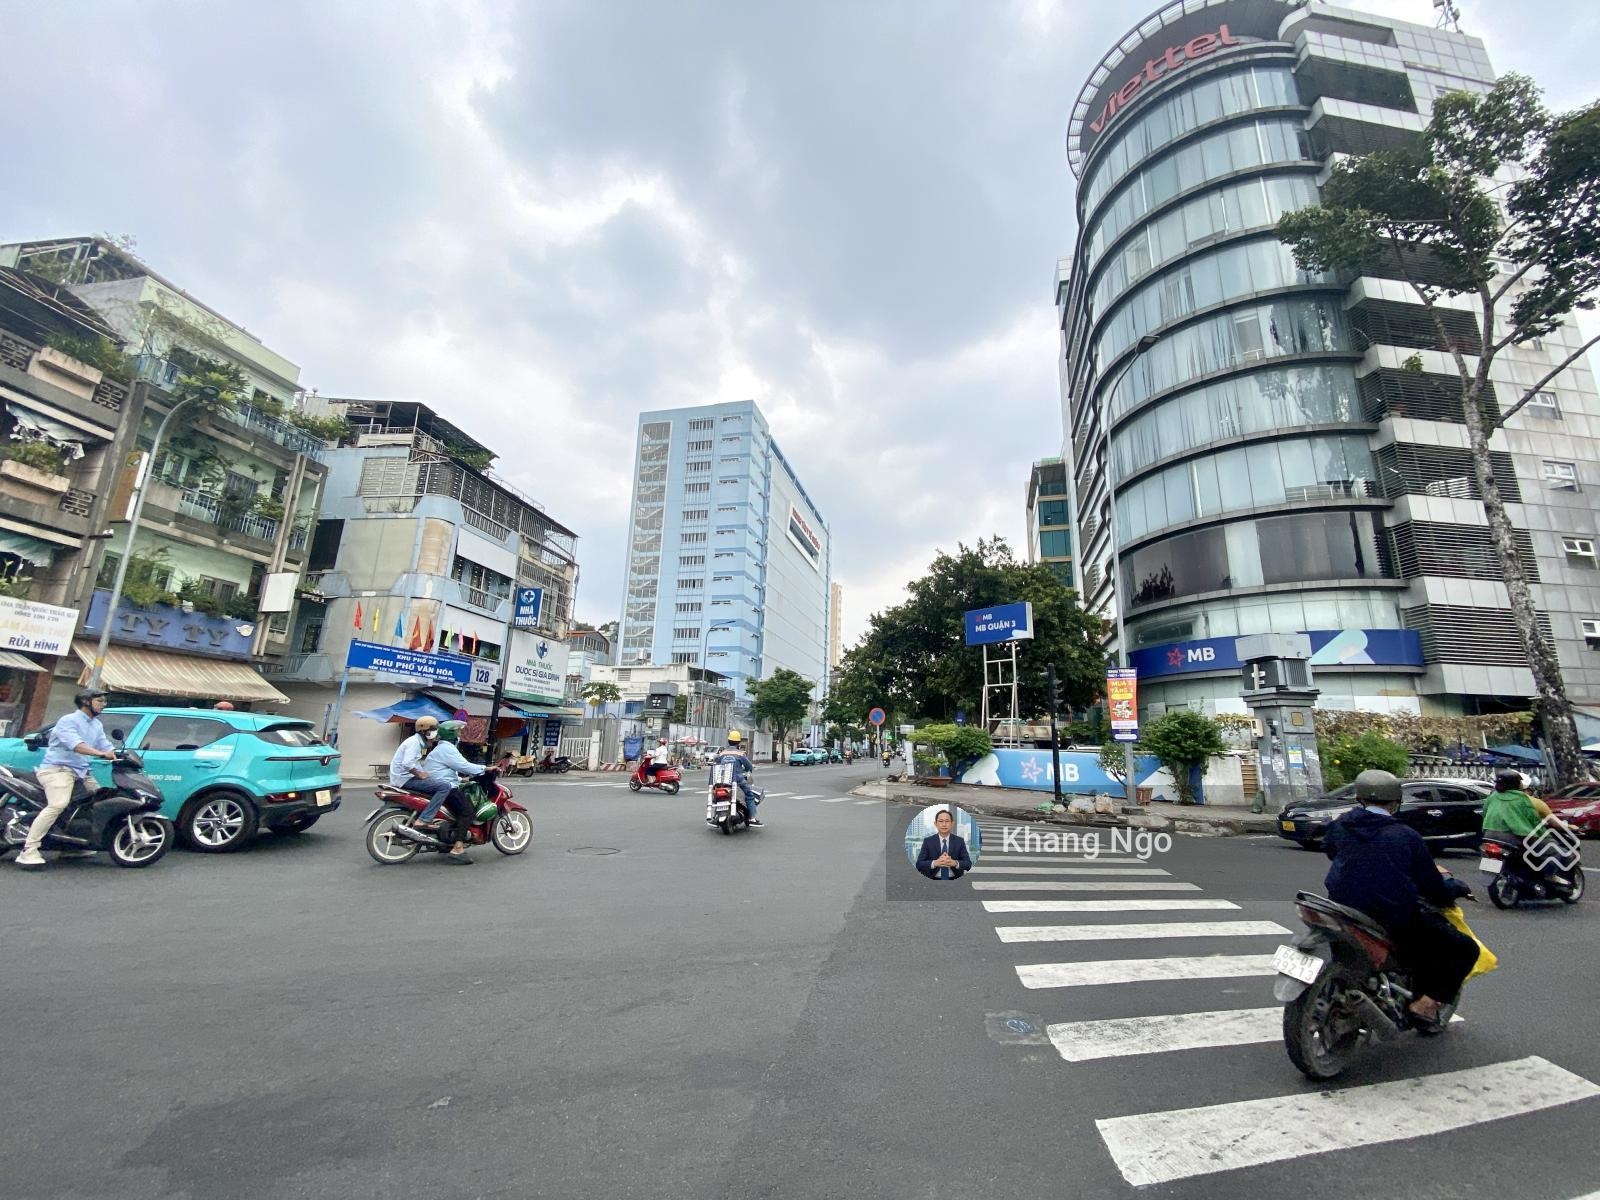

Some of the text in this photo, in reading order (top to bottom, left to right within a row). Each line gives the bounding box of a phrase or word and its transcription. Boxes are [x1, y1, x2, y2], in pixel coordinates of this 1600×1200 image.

[519, 604, 534, 615] NHÀ
[982, 613, 993, 621] MB
[975, 624, 987, 632] MB
[987, 619, 1010, 631] QUẬN
[1187, 647, 1216, 663] MB
[372, 658, 393, 667] KHU
[395, 661, 415, 671] PHỐ
[417, 664, 435, 674] VĂN
[436, 667, 453, 677] HÓA
[475, 668, 490, 683] 128
[1046, 762, 1080, 782] MB
